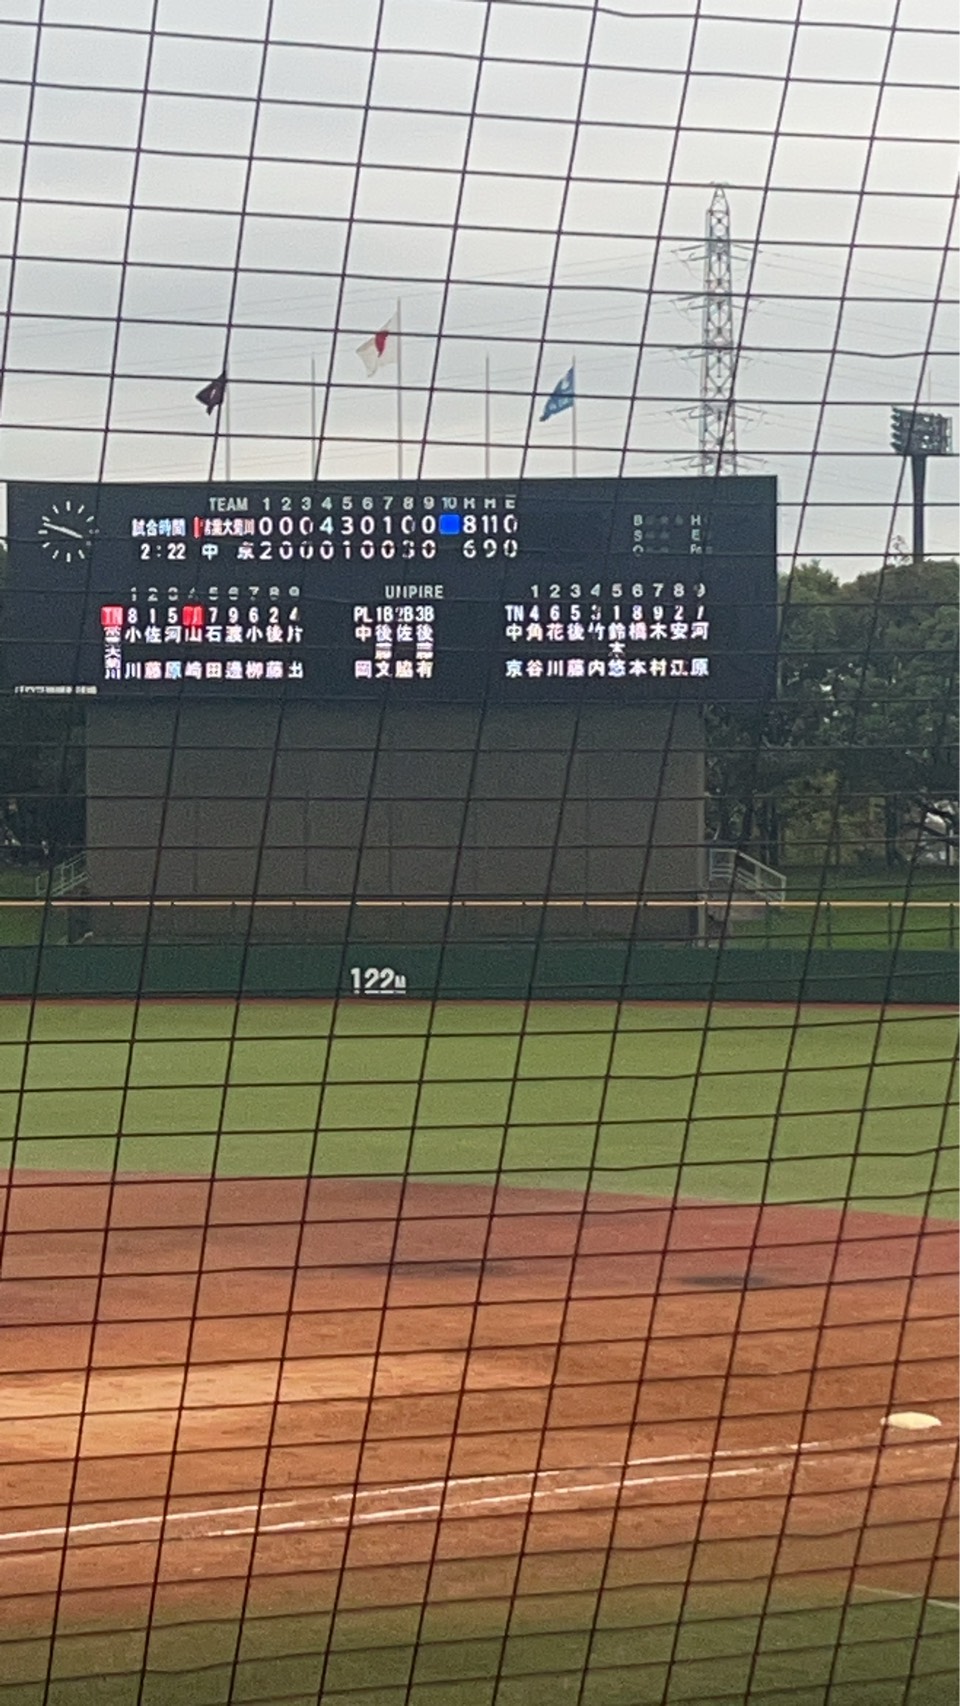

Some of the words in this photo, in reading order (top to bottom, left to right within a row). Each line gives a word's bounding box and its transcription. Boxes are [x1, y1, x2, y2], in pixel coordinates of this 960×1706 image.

[209, 496, 248, 511] TEAM
[262, 496, 270, 511] 1
[281, 496, 292, 511] 2
[301, 496, 312, 511] 3
[321, 496, 333, 511] 4
[342, 496, 353, 510] 5
[361, 496, 374, 510] 6
[383, 496, 394, 510] 7
[402, 496, 414, 510] 8
[423, 496, 435, 510] 9
[442, 496, 458, 510] 10
[505, 494, 517, 509] E
[131, 518, 186, 537] 試合時間
[259, 516, 273, 536] 0
[279, 516, 293, 536] 0
[299, 516, 314, 536] 0
[319, 516, 334, 535] 4
[341, 516, 354, 535] 3
[360, 515, 375, 535] 0
[383, 515, 392, 535] 1
[421, 515, 436, 534] 0
[463, 514, 477, 534] 8
[481, 514, 498, 534] 11
[503, 514, 518, 533] 0
[633, 514, 643, 526] B
[690, 514, 701, 526] H
[633, 529, 643, 542] S
[691, 528, 701, 541] E
[140, 543, 186, 560] 2:22
[259, 541, 273, 560] 2
[279, 541, 293, 560] 0
[320, 540, 334, 560] 0
[342, 540, 351, 559] 1
[360, 540, 375, 559] 0
[381, 540, 396, 559] 0
[421, 540, 436, 559] 0
[463, 539, 477, 558] 6
[483, 538, 497, 558] 9
[503, 539, 518, 558] 0
[130, 586, 137, 602] 1
[147, 587, 159, 602] 2
[530, 584, 539, 599] 1
[549, 584, 561, 599] 2
[570, 583, 582, 599] 3
[590, 583, 601, 597] 4
[611, 583, 622, 598] 5
[632, 583, 643, 598] 6
[652, 583, 664, 598] 7
[673, 583, 685, 598] 8
[127, 606, 138, 624] 8
[149, 607, 156, 624] 1
[167, 606, 178, 624] 5
[208, 606, 219, 623] 7
[228, 606, 239, 624] 9
[248, 606, 260, 624] 6
[268, 606, 279, 624] 2
[353, 605, 374, 623] PL
[376, 605, 394, 622] 1B
[415, 605, 434, 622] 3B
[504, 604, 525, 622] TN
[529, 604, 540, 622] 4
[549, 604, 560, 621] 6
[570, 604, 581, 621] 5
[613, 604, 620, 621] 1
[632, 604, 643, 621] 8
[652, 604, 664, 621] 9
[673, 604, 684, 621] 2
[124, 625, 142, 680] 小川
[205, 625, 223, 680] 石田
[505, 622, 523, 678] 中京
[649, 620, 668, 678] 木村
